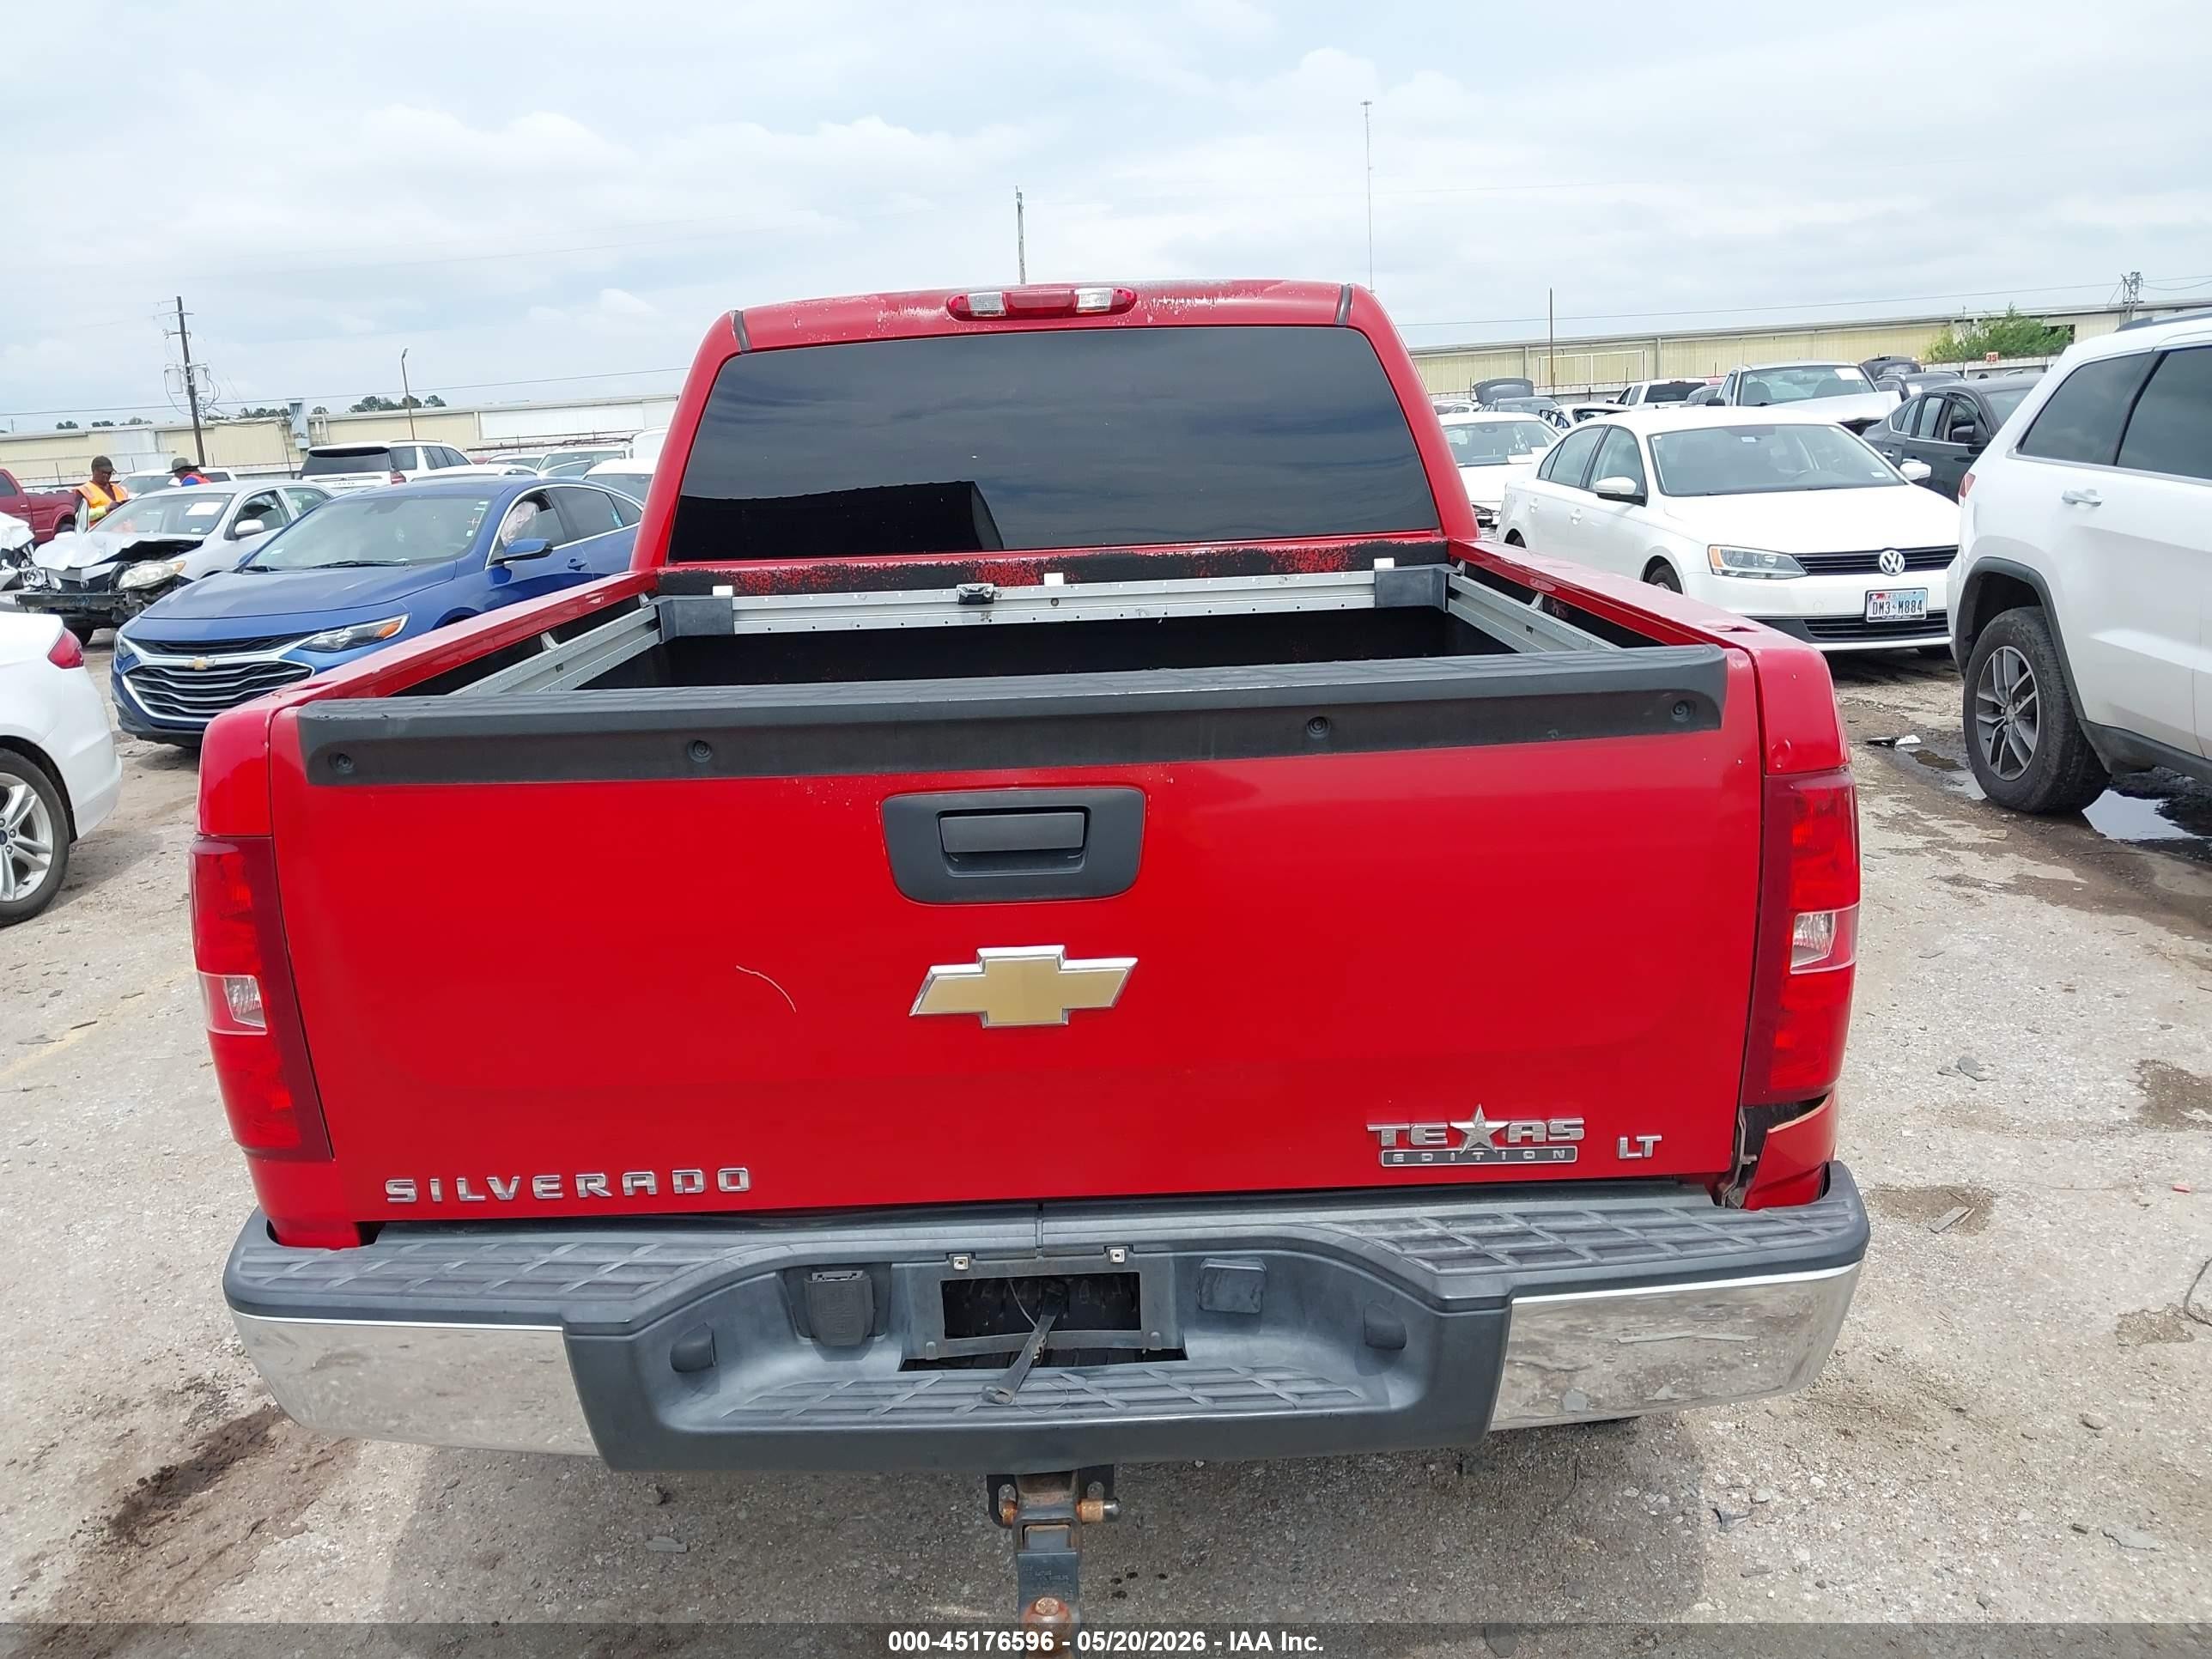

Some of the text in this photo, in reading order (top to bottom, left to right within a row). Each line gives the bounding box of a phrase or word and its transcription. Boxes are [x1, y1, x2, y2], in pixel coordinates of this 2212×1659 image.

[1392, 1149, 1566, 1163] EDITION
[1619, 1134, 1662, 1159] LT
[385, 1167, 751, 1203] SILVERADO
